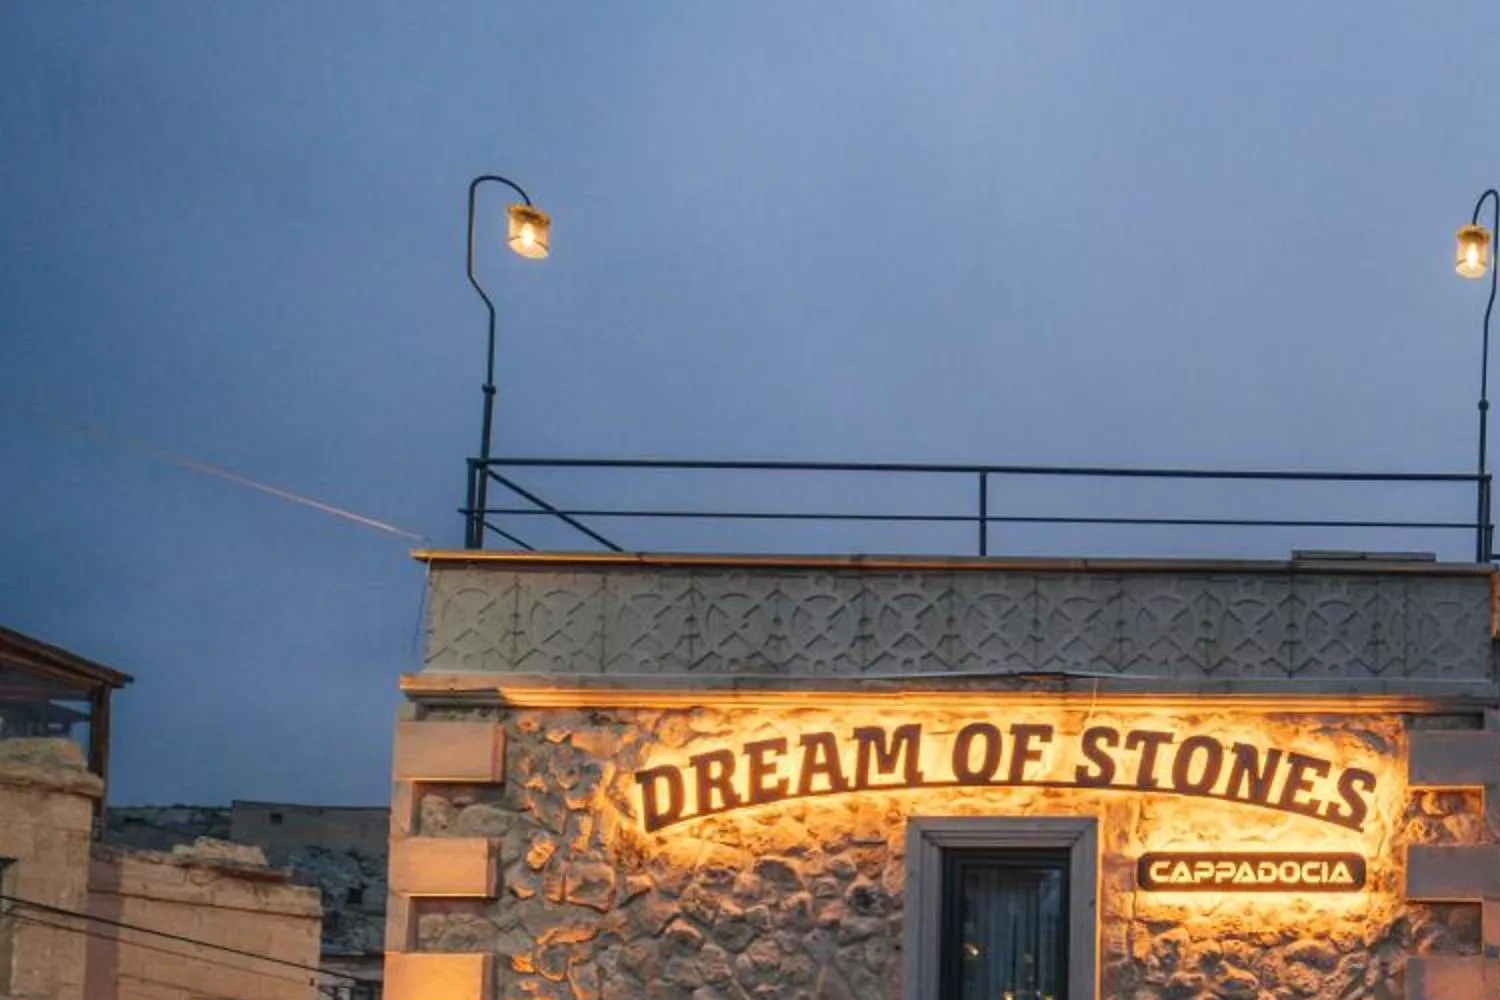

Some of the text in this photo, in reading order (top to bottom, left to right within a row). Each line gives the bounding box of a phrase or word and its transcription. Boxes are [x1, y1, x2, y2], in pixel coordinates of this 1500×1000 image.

[635, 722, 1377, 832] DREAM OF STONES
[1150, 860, 1355, 885] CAPPADOCIA
